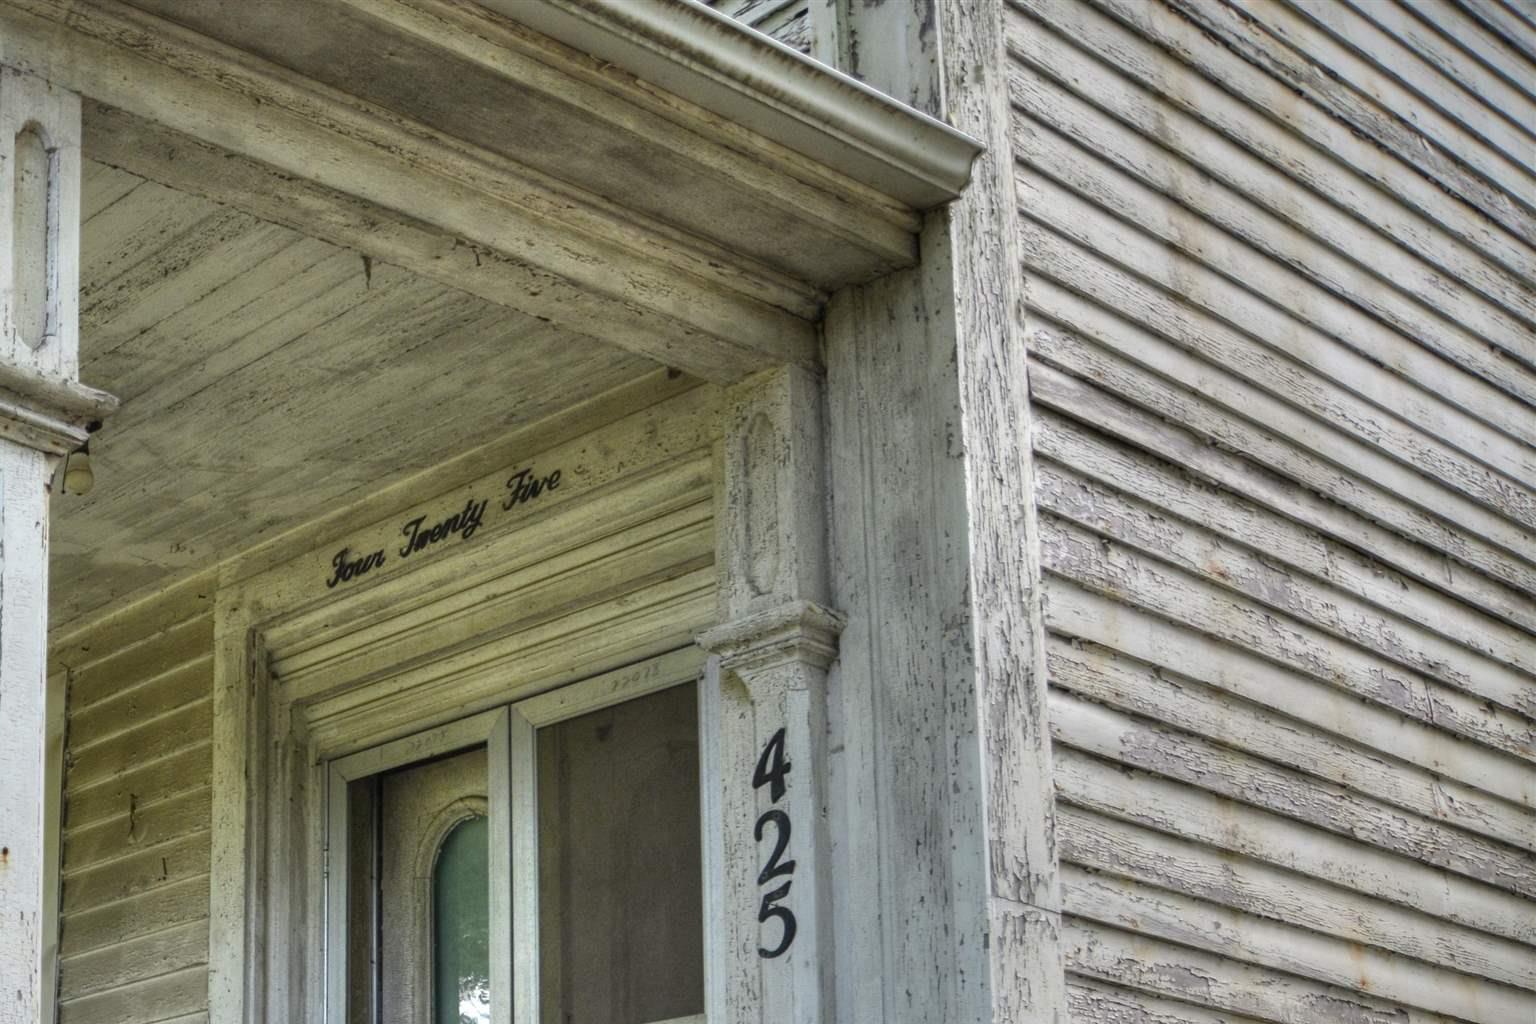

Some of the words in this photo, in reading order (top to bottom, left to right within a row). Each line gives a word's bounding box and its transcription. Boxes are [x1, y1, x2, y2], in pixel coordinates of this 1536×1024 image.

[326, 547, 385, 588] Four
[399, 500, 488, 558] Twenty
[503, 468, 561, 511] Five
[752, 727, 797, 960] 425
